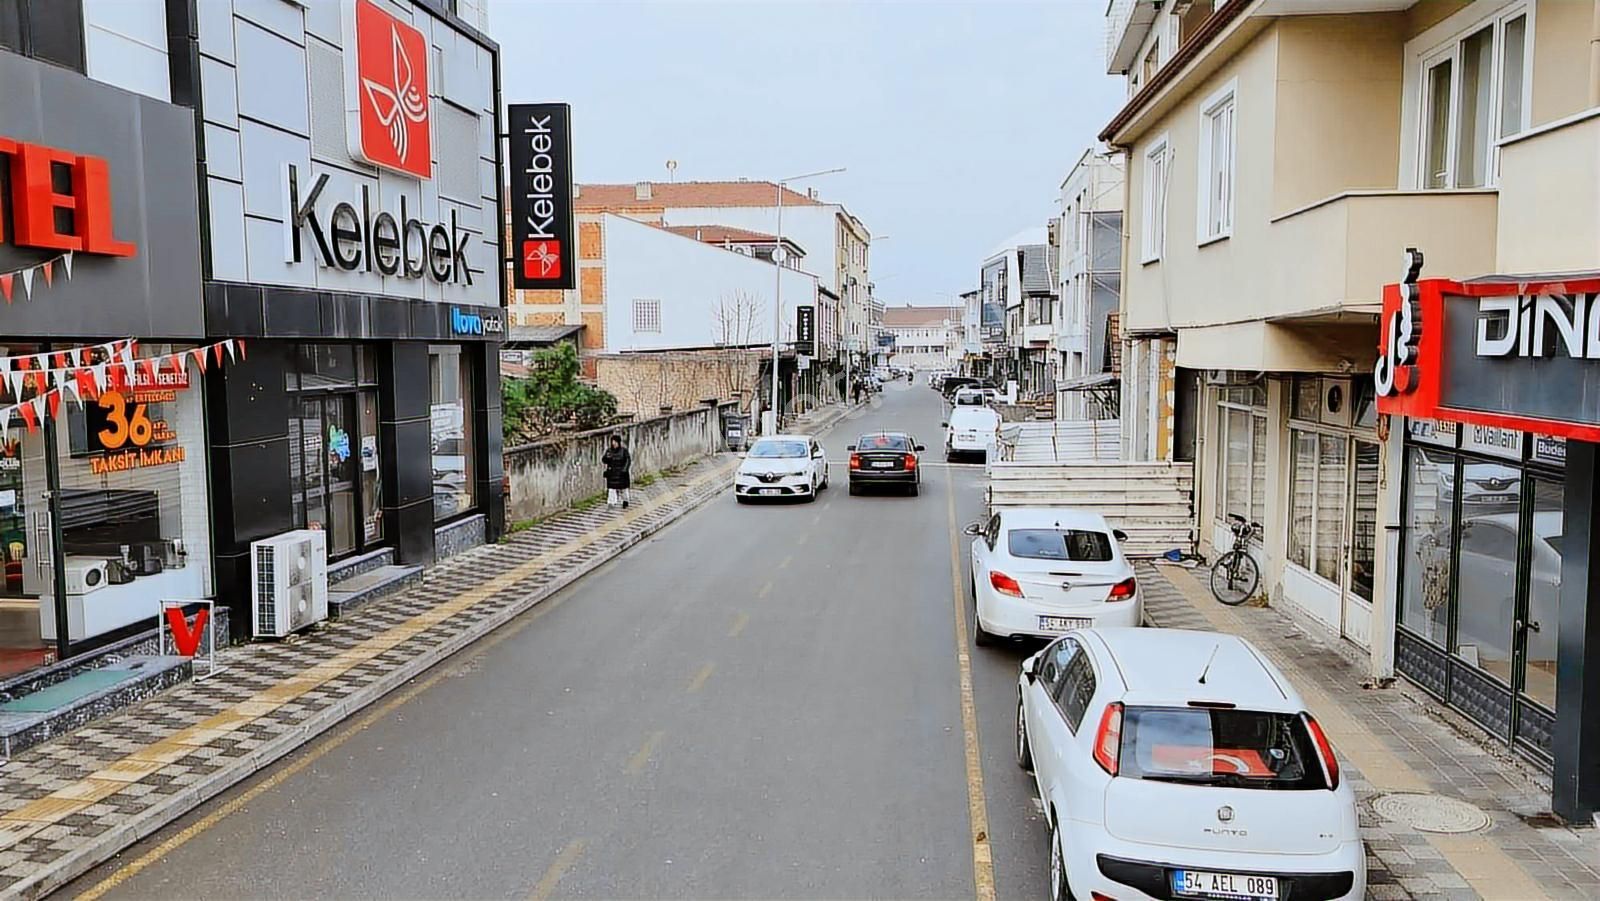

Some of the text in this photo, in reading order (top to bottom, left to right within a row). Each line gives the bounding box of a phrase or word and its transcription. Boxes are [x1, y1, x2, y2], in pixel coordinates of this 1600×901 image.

[524, 115, 554, 238] Kelebek
[280, 161, 474, 286] Kelebek
[98, 391, 151, 448] 36
[90, 450, 136, 474] TAKSİT
[1185, 873, 1274, 895] 54 AEL 089
